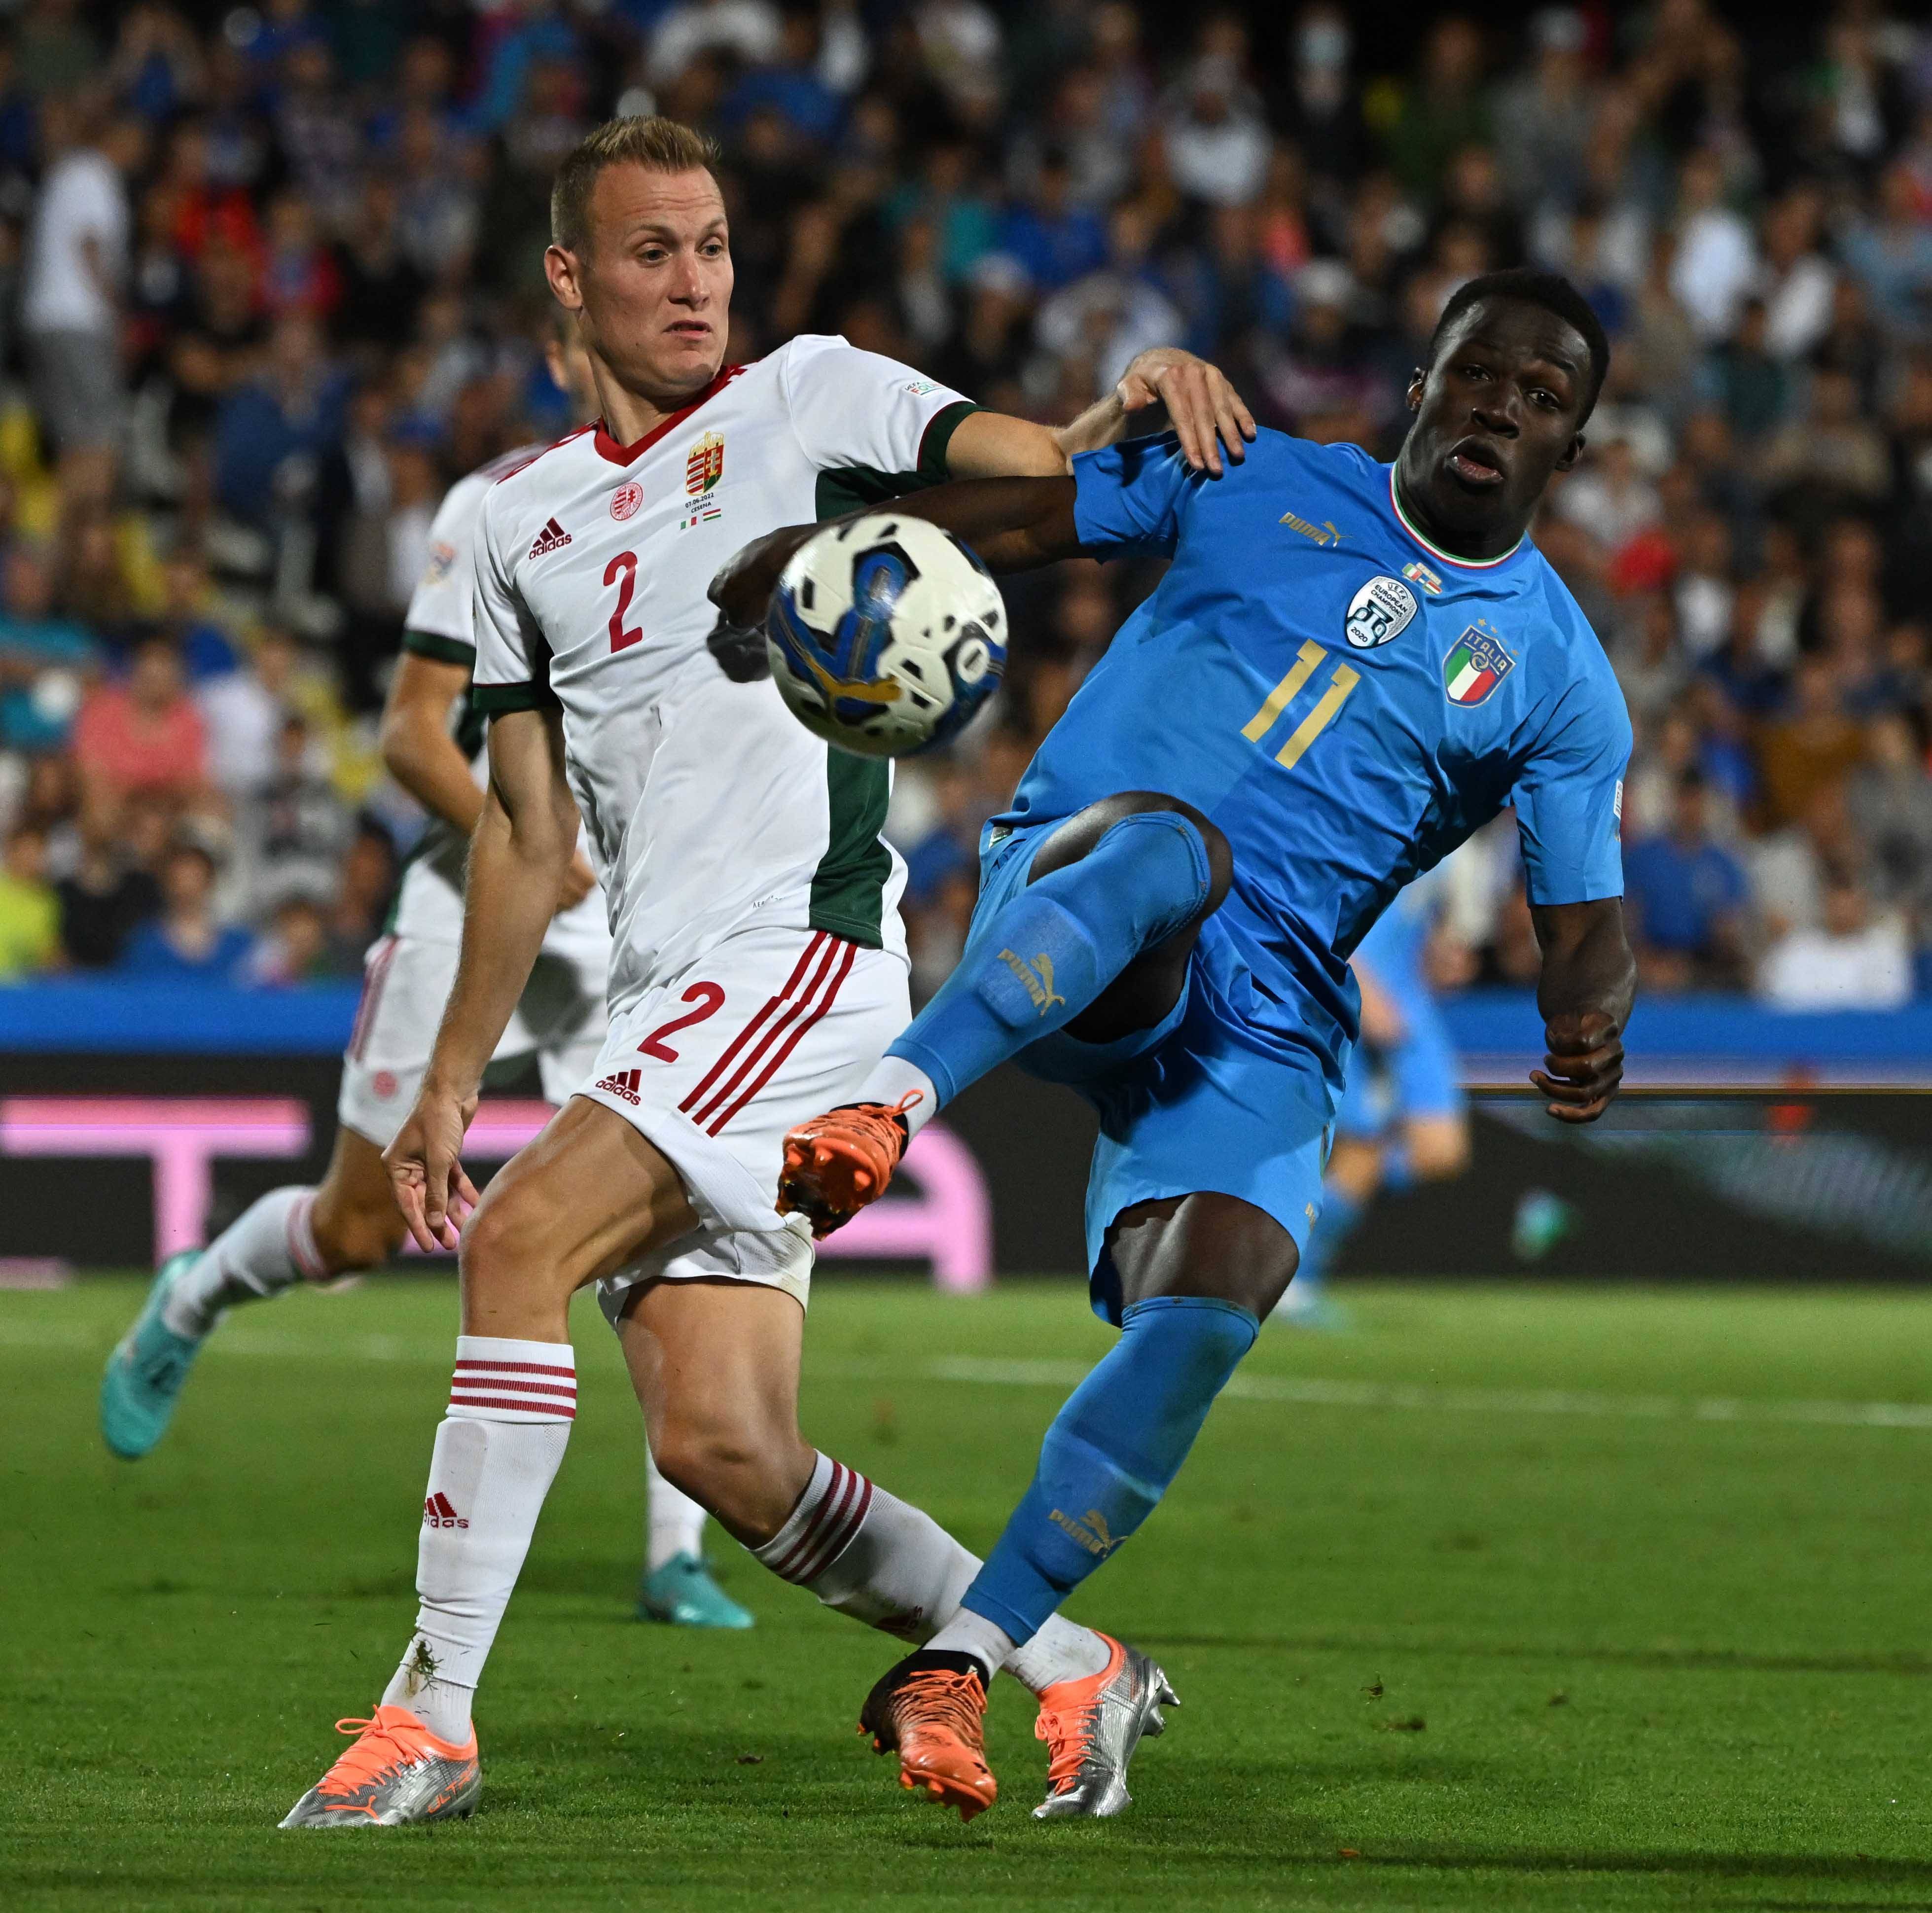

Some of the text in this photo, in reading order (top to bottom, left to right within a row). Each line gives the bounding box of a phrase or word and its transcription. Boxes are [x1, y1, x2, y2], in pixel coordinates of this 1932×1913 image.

[685, 492, 714, 508] 07.06.2022
[691, 502, 712, 513] CESENA
[529, 534, 572, 560] adidas
[603, 551, 643, 654] 2
[1371, 589, 1403, 617] CHAMPIONS
[1374, 584, 1408, 613] EUROPEAN
[1388, 583, 1406, 600] UEFA
[1351, 627, 1368, 642] 2020
[1467, 633, 1507, 671] ITALIA
[1240, 638, 1361, 770] 11
[637, 981, 725, 1063] 2
[595, 1080, 641, 1105] adidas
[424, 1514, 469, 1528] idas
